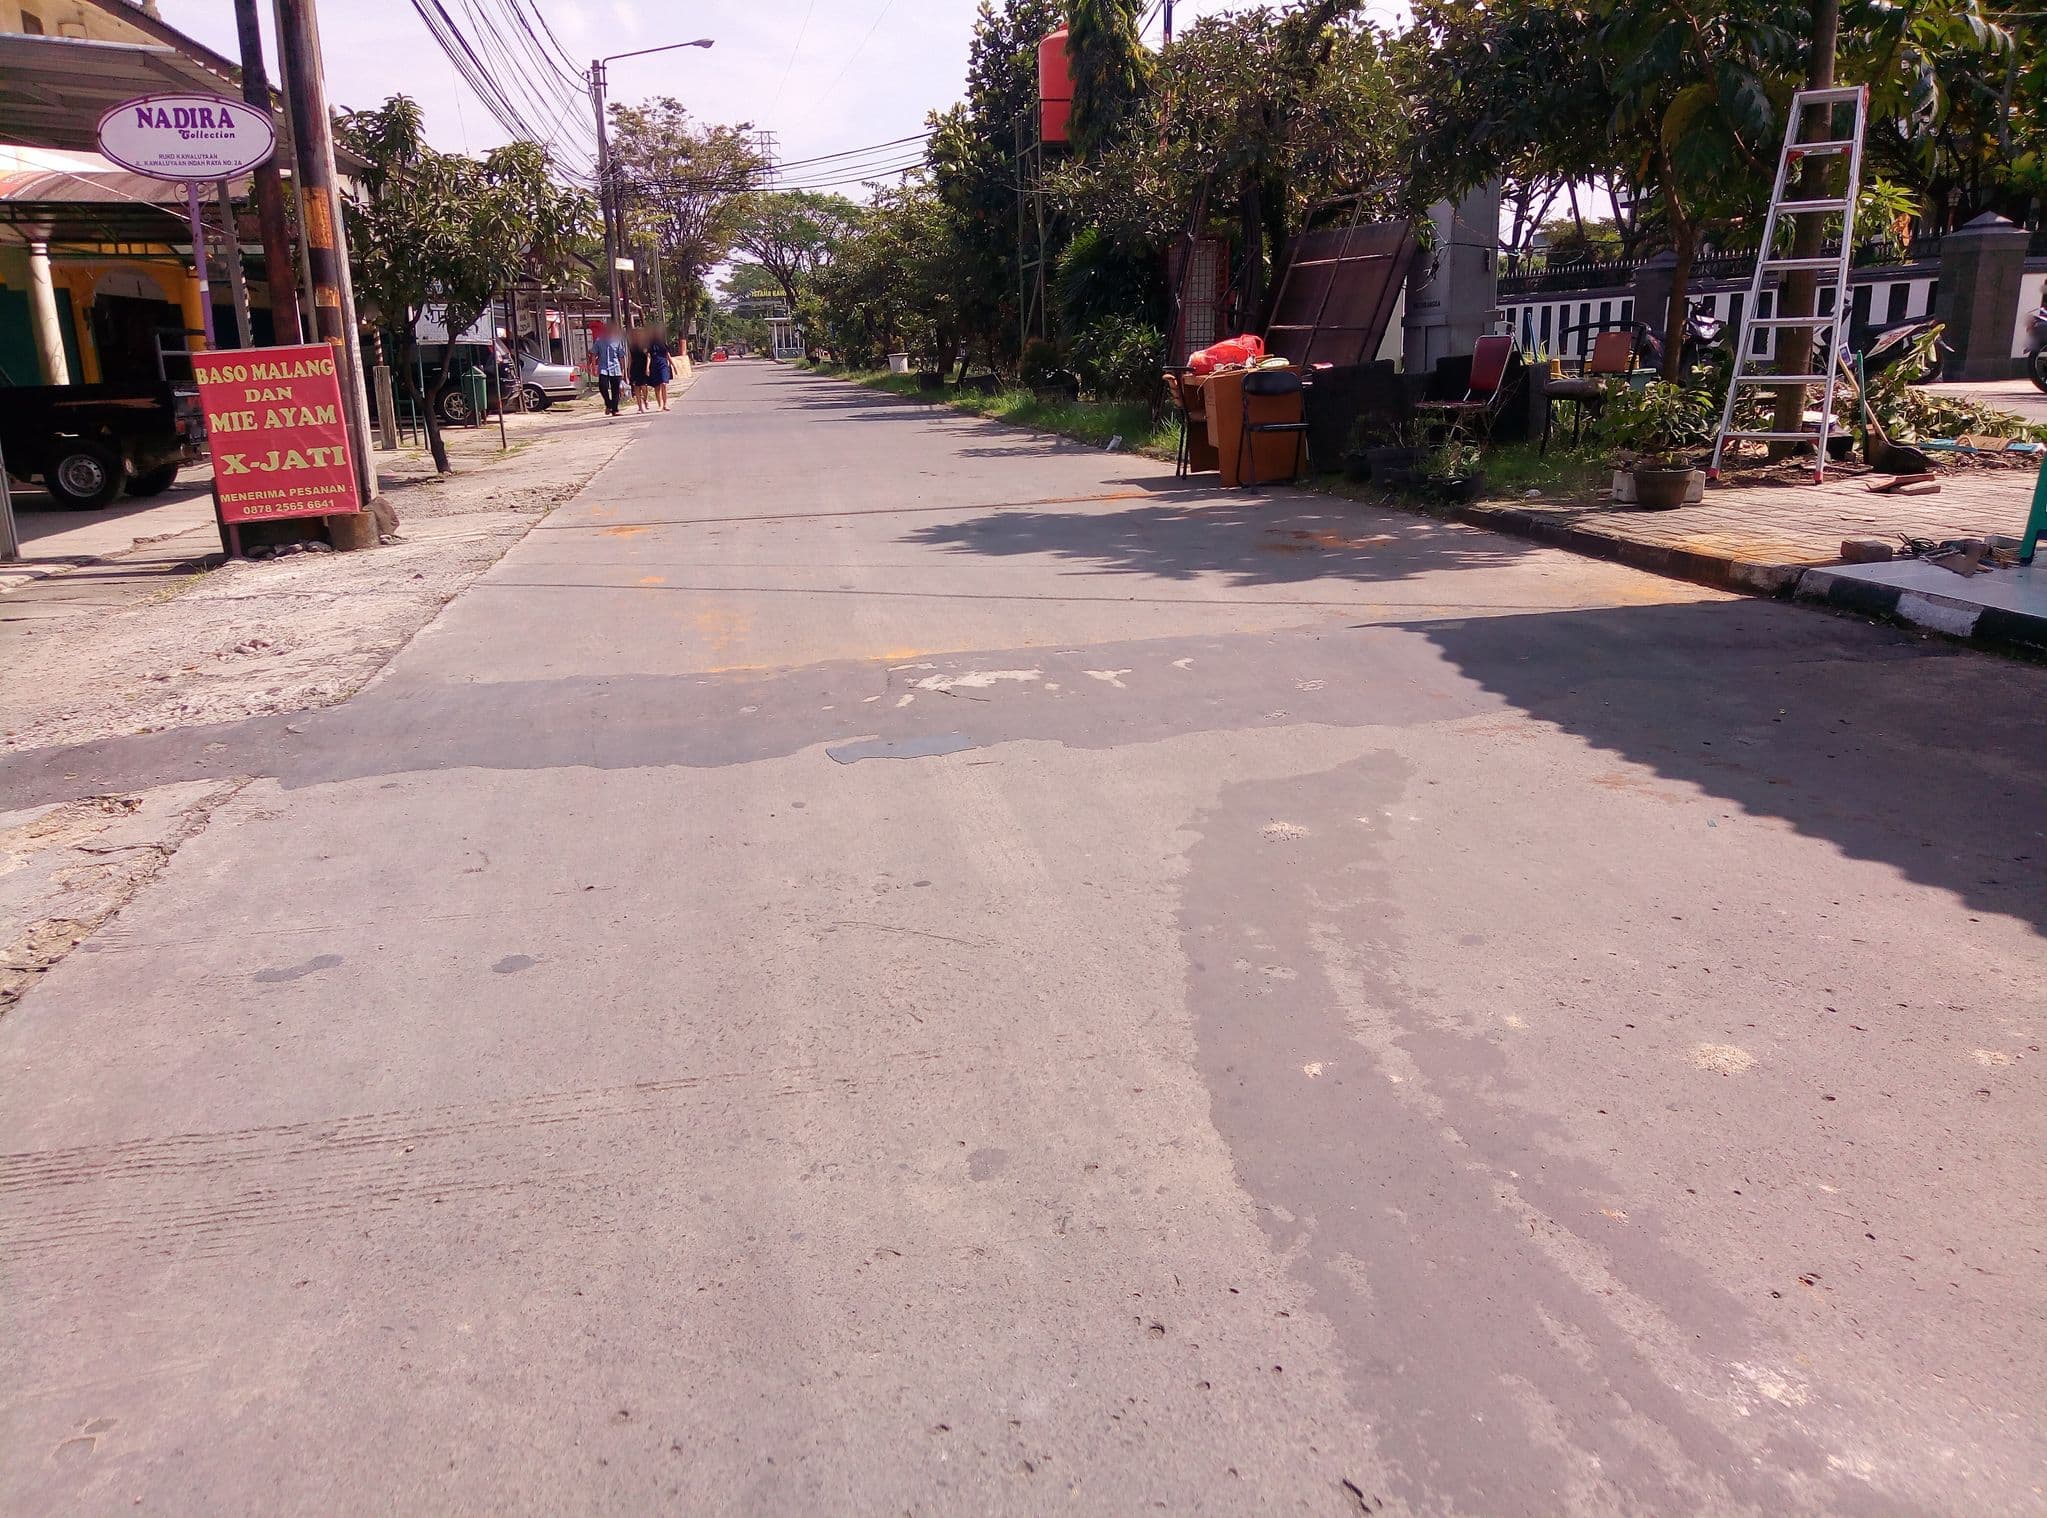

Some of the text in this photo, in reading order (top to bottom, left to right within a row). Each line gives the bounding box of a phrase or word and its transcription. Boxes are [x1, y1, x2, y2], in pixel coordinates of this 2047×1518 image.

[135, 107, 236, 129] NADIRA
[178, 129, 236, 140] Collection
[195, 359, 335, 386] BASO MALANG
[244, 386, 293, 403] DAN
[209, 404, 338, 433] MIE AYAM
[220, 446, 346, 475] X-JATI
[220, 487, 286, 503] MENERIMA
[289, 484, 346, 497] PESANAN
[243, 504, 272, 515] 0878
[275, 501, 304, 512] 2565
